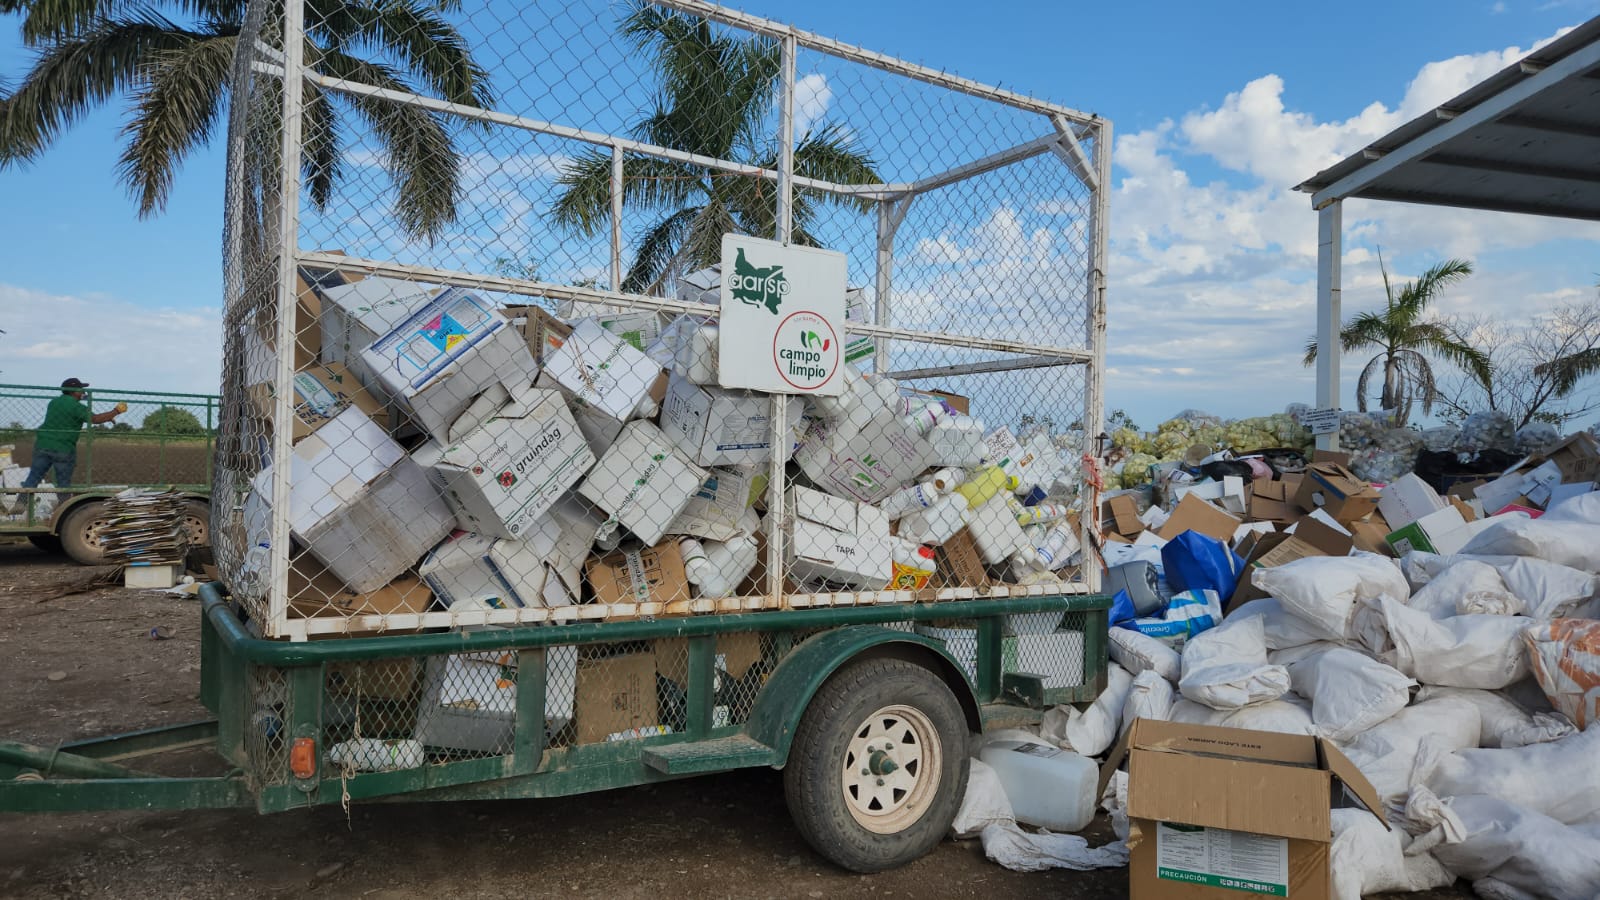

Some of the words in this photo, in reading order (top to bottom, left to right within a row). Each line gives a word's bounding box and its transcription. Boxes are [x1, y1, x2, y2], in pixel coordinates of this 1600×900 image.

[780, 348, 821, 364] campo
[789, 360, 826, 380] limpio
[516, 426, 562, 473] gruindag
[835, 545, 856, 556] TAPA
[1160, 869, 1208, 883] PRECAUCIÓN
